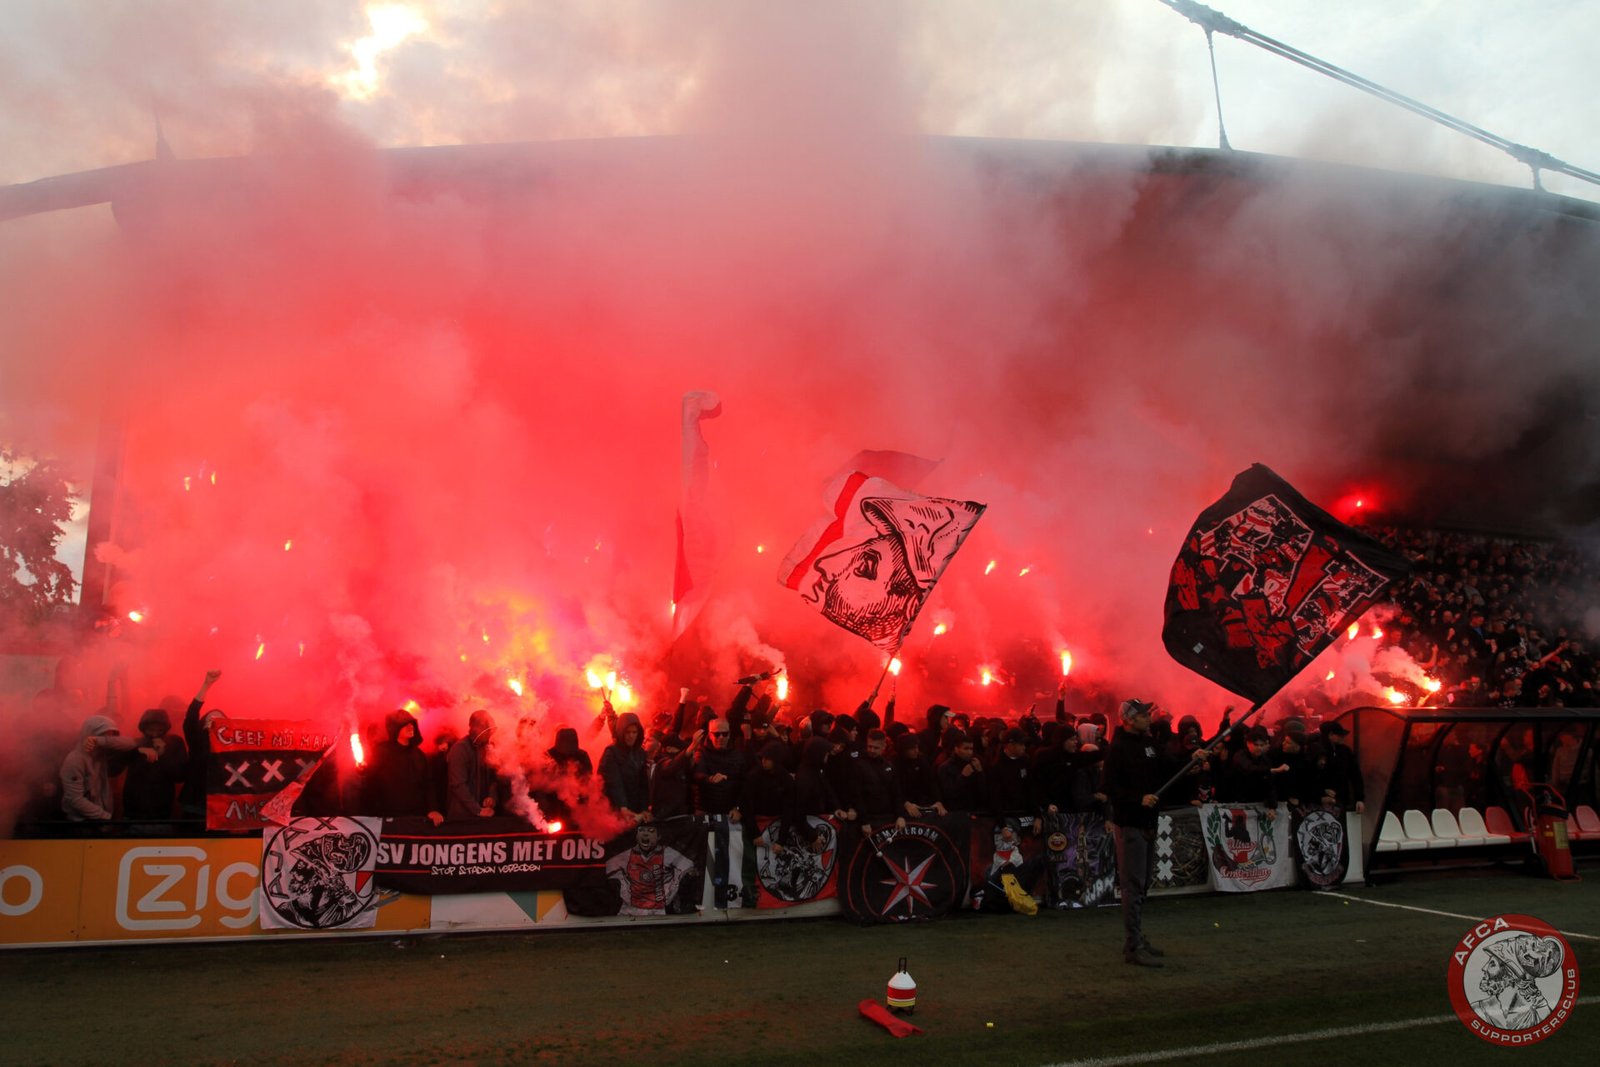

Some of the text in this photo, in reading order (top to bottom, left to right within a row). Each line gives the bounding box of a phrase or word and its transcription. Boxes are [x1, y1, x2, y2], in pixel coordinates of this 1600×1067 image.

[217, 727, 265, 746] GEEF
[268, 816, 338, 899] AJAX
[376, 838, 605, 866] SV JONGENS MET ONS
[431, 863, 541, 876] STOP STADION VERBODEN
